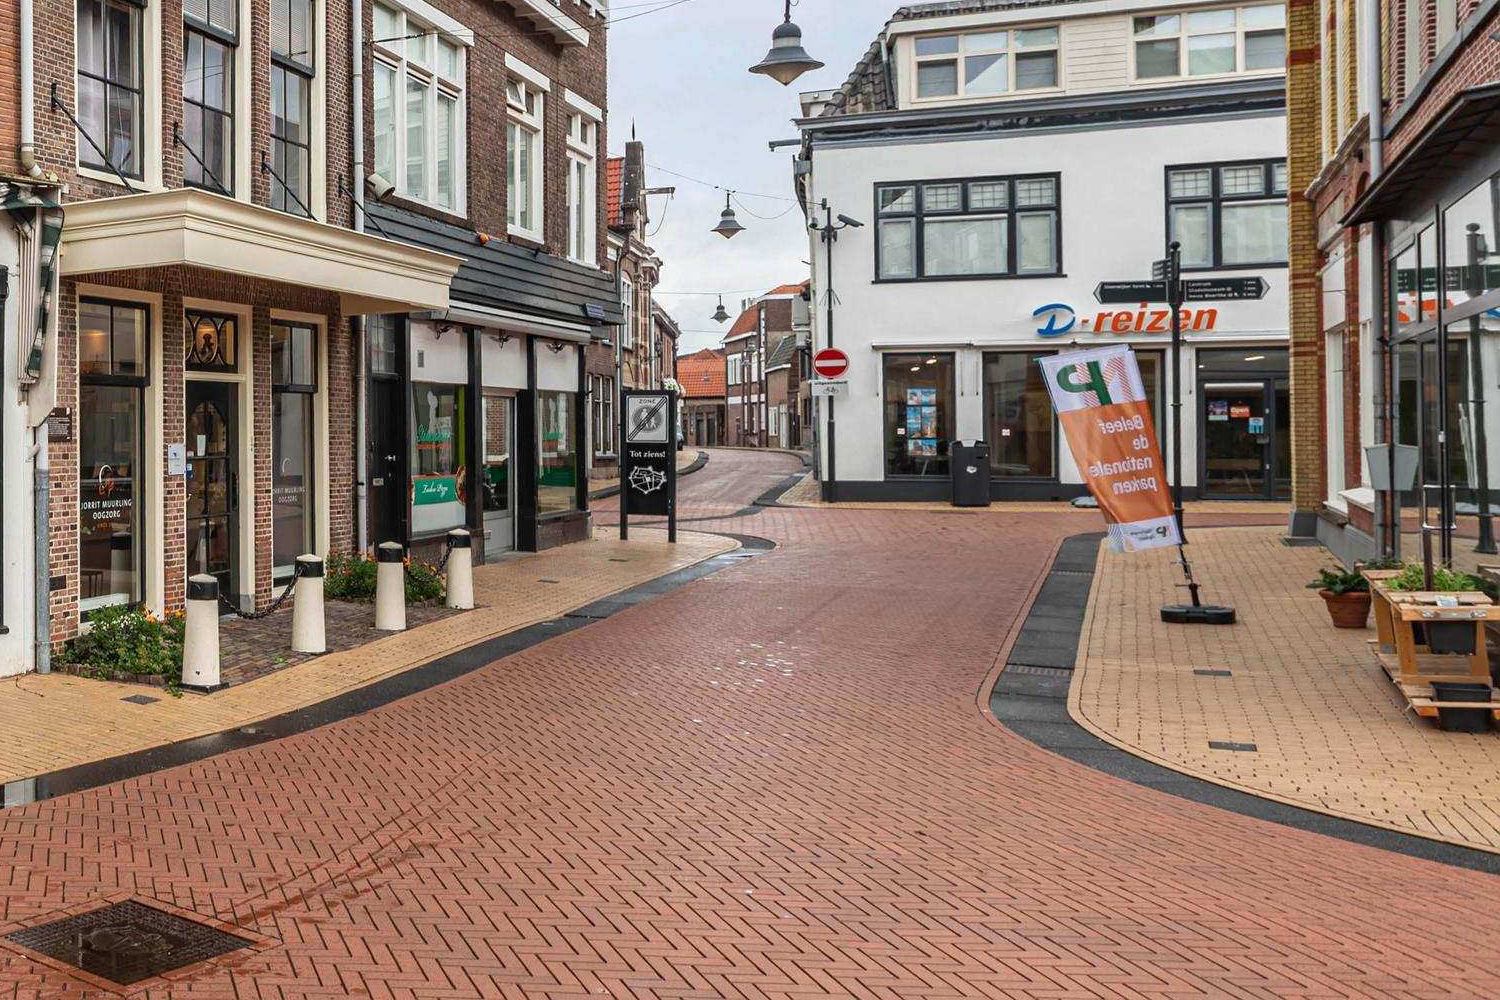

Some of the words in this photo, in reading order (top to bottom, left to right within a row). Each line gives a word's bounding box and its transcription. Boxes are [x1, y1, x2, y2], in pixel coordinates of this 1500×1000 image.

[1032, 302, 1218, 337] D-reizen
[630, 450, 641, 458] Tot
[644, 450, 666, 458] ziens!
[81, 500, 101, 510] JORRIT
[102, 499, 132, 508] MUURLING
[93, 510, 121, 519] OOGZORG
